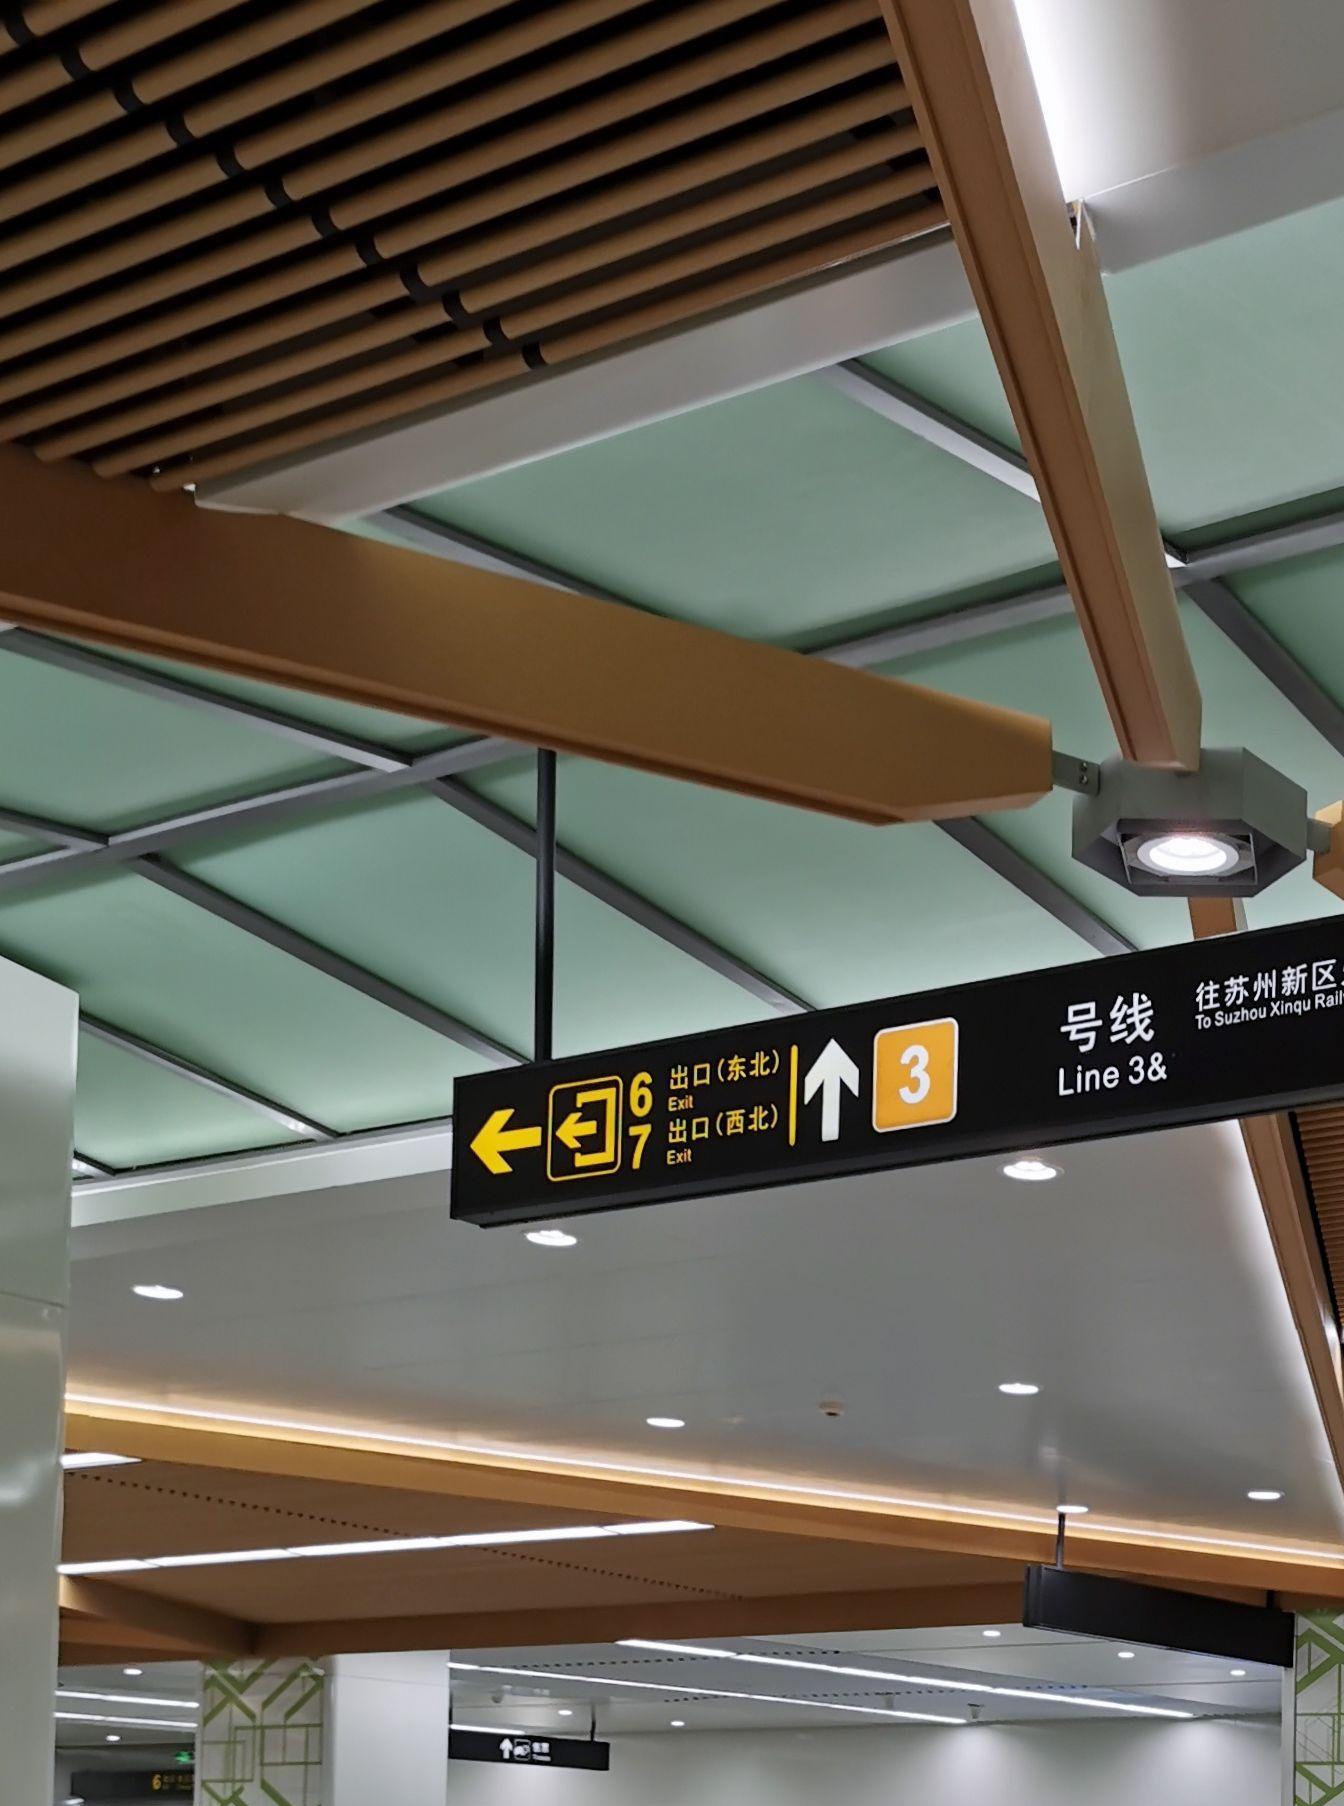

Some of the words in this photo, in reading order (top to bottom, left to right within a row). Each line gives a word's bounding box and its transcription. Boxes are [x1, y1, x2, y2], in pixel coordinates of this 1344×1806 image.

[1060, 992, 1156, 1053] 号线
[1195, 1014, 1211, 1030] To
[1214, 1006, 1267, 1027] Suzhou
[1270, 998, 1312, 1018] Xinqu
[669, 1049, 780, 1091] 出口（东北）
[897, 1043, 932, 1105] 3
[1058, 1065, 1119, 1097] Line
[1128, 1052, 1168, 1085] 3&
[630, 1072, 653, 1117] 6
[668, 1094, 694, 1113] Exit
[668, 1103, 778, 1144] 出口（西北）
[628, 1123, 652, 1170] 7
[666, 1147, 692, 1166] Exit
